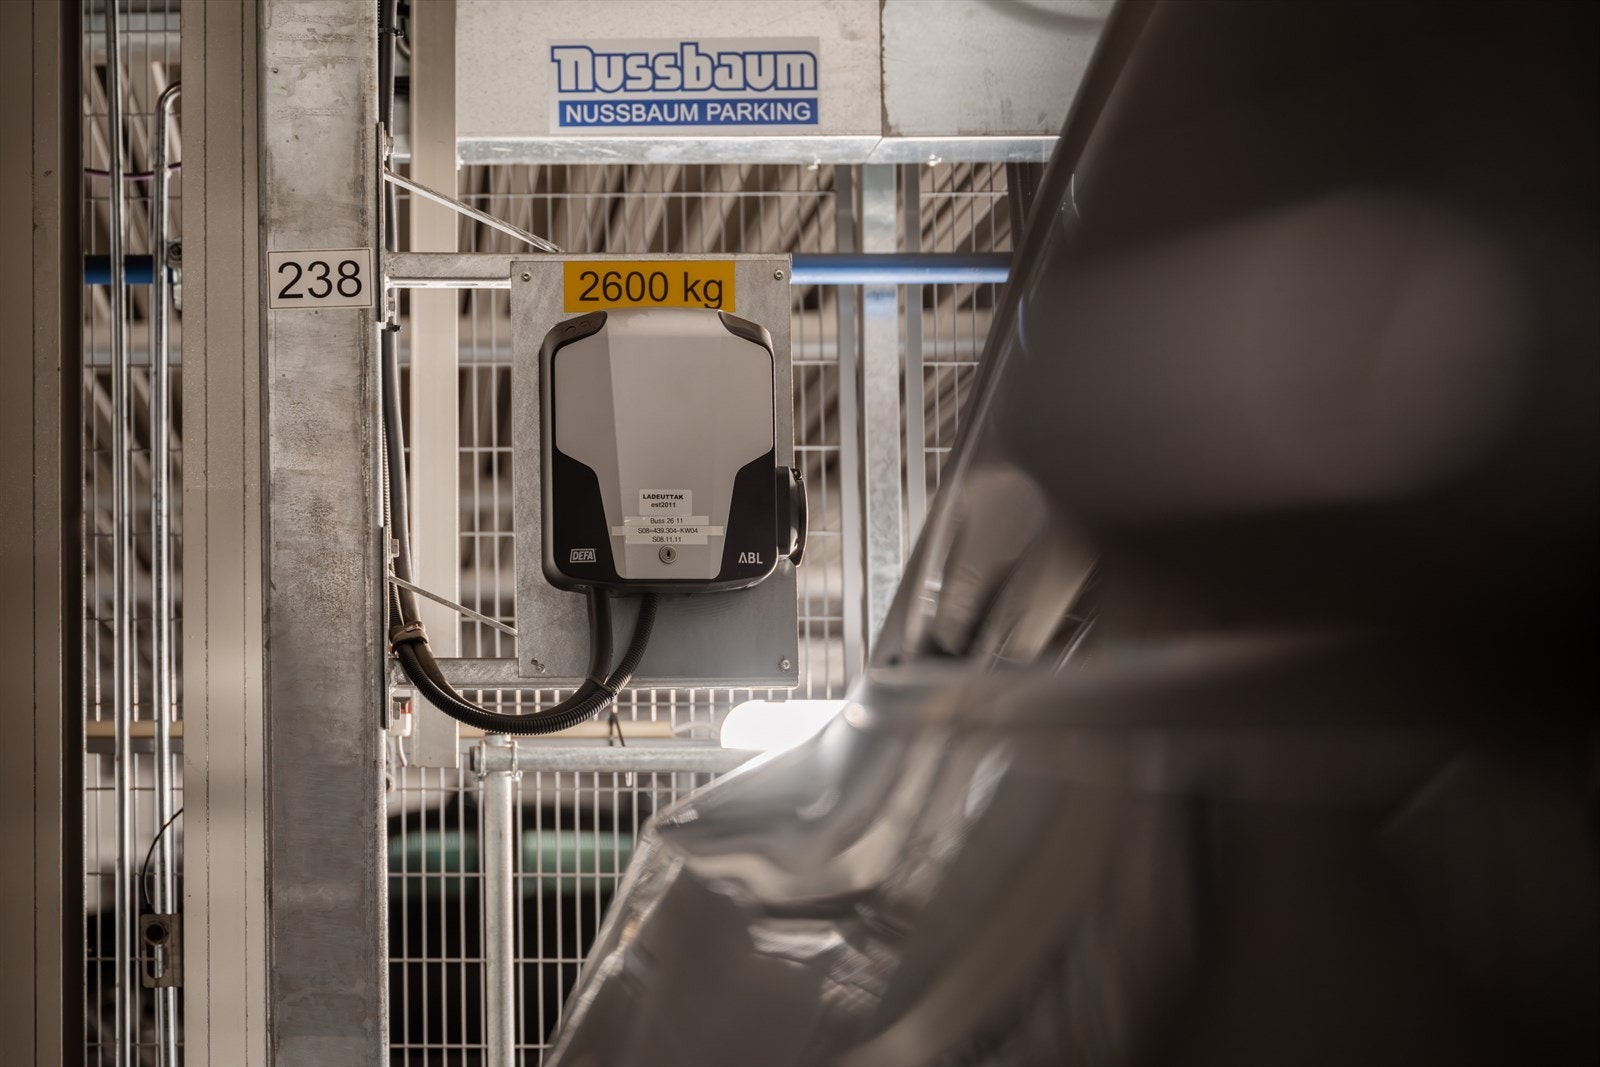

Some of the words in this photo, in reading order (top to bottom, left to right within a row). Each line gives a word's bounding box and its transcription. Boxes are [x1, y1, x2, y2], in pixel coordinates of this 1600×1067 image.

[565, 103, 699, 123] NUSSBAUM
[706, 101, 811, 121] PARKING
[277, 260, 362, 299] 238
[578, 271, 669, 302] 2600
[683, 271, 723, 309] kg
[572, 550, 594, 561] DEFA
[738, 552, 763, 565] ABL
